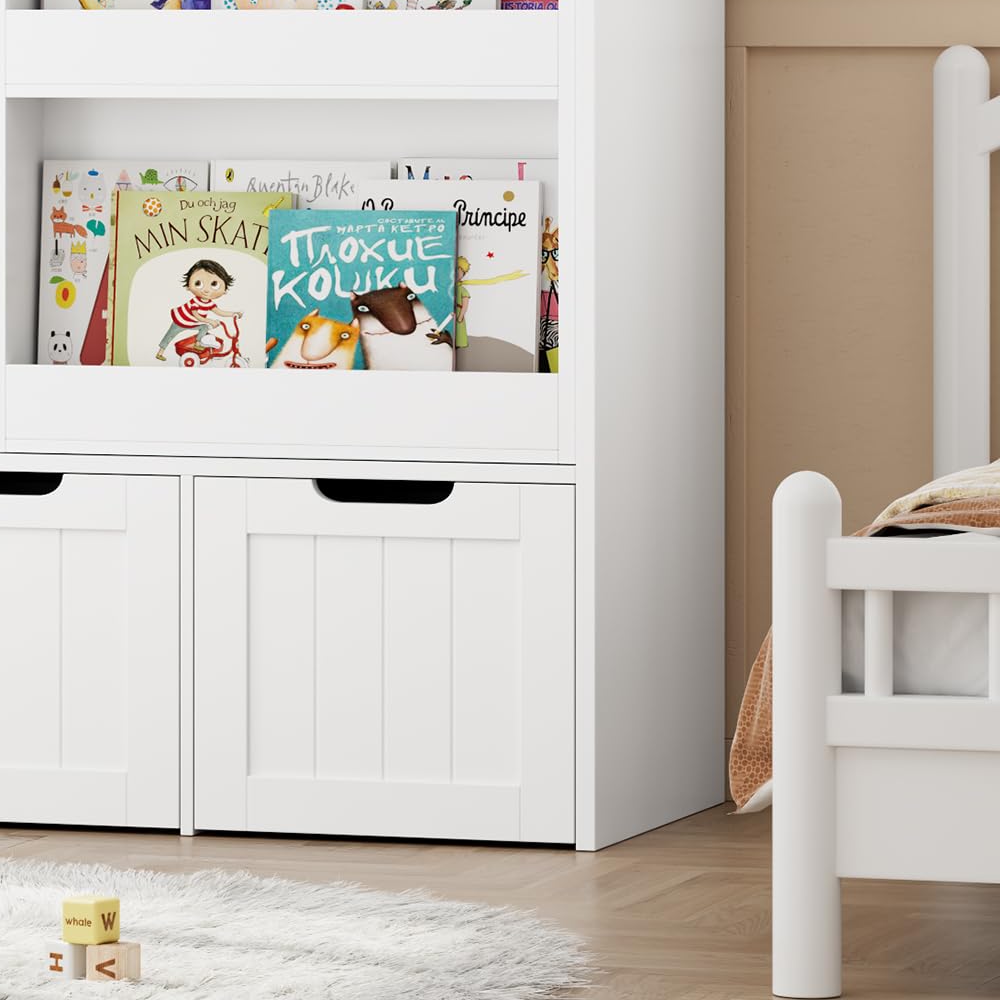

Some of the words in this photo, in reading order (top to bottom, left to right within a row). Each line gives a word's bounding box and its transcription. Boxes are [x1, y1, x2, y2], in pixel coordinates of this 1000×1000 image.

[306, 172, 355, 203] Blake
[180, 199, 195, 211] Du
[197, 197, 216, 207] och
[213, 199, 237, 213] jag
[134, 218, 188, 259] MIN
[197, 214, 268, 256] SKAT
[65, 917, 93, 928] whale
[101, 911, 117, 931] W
